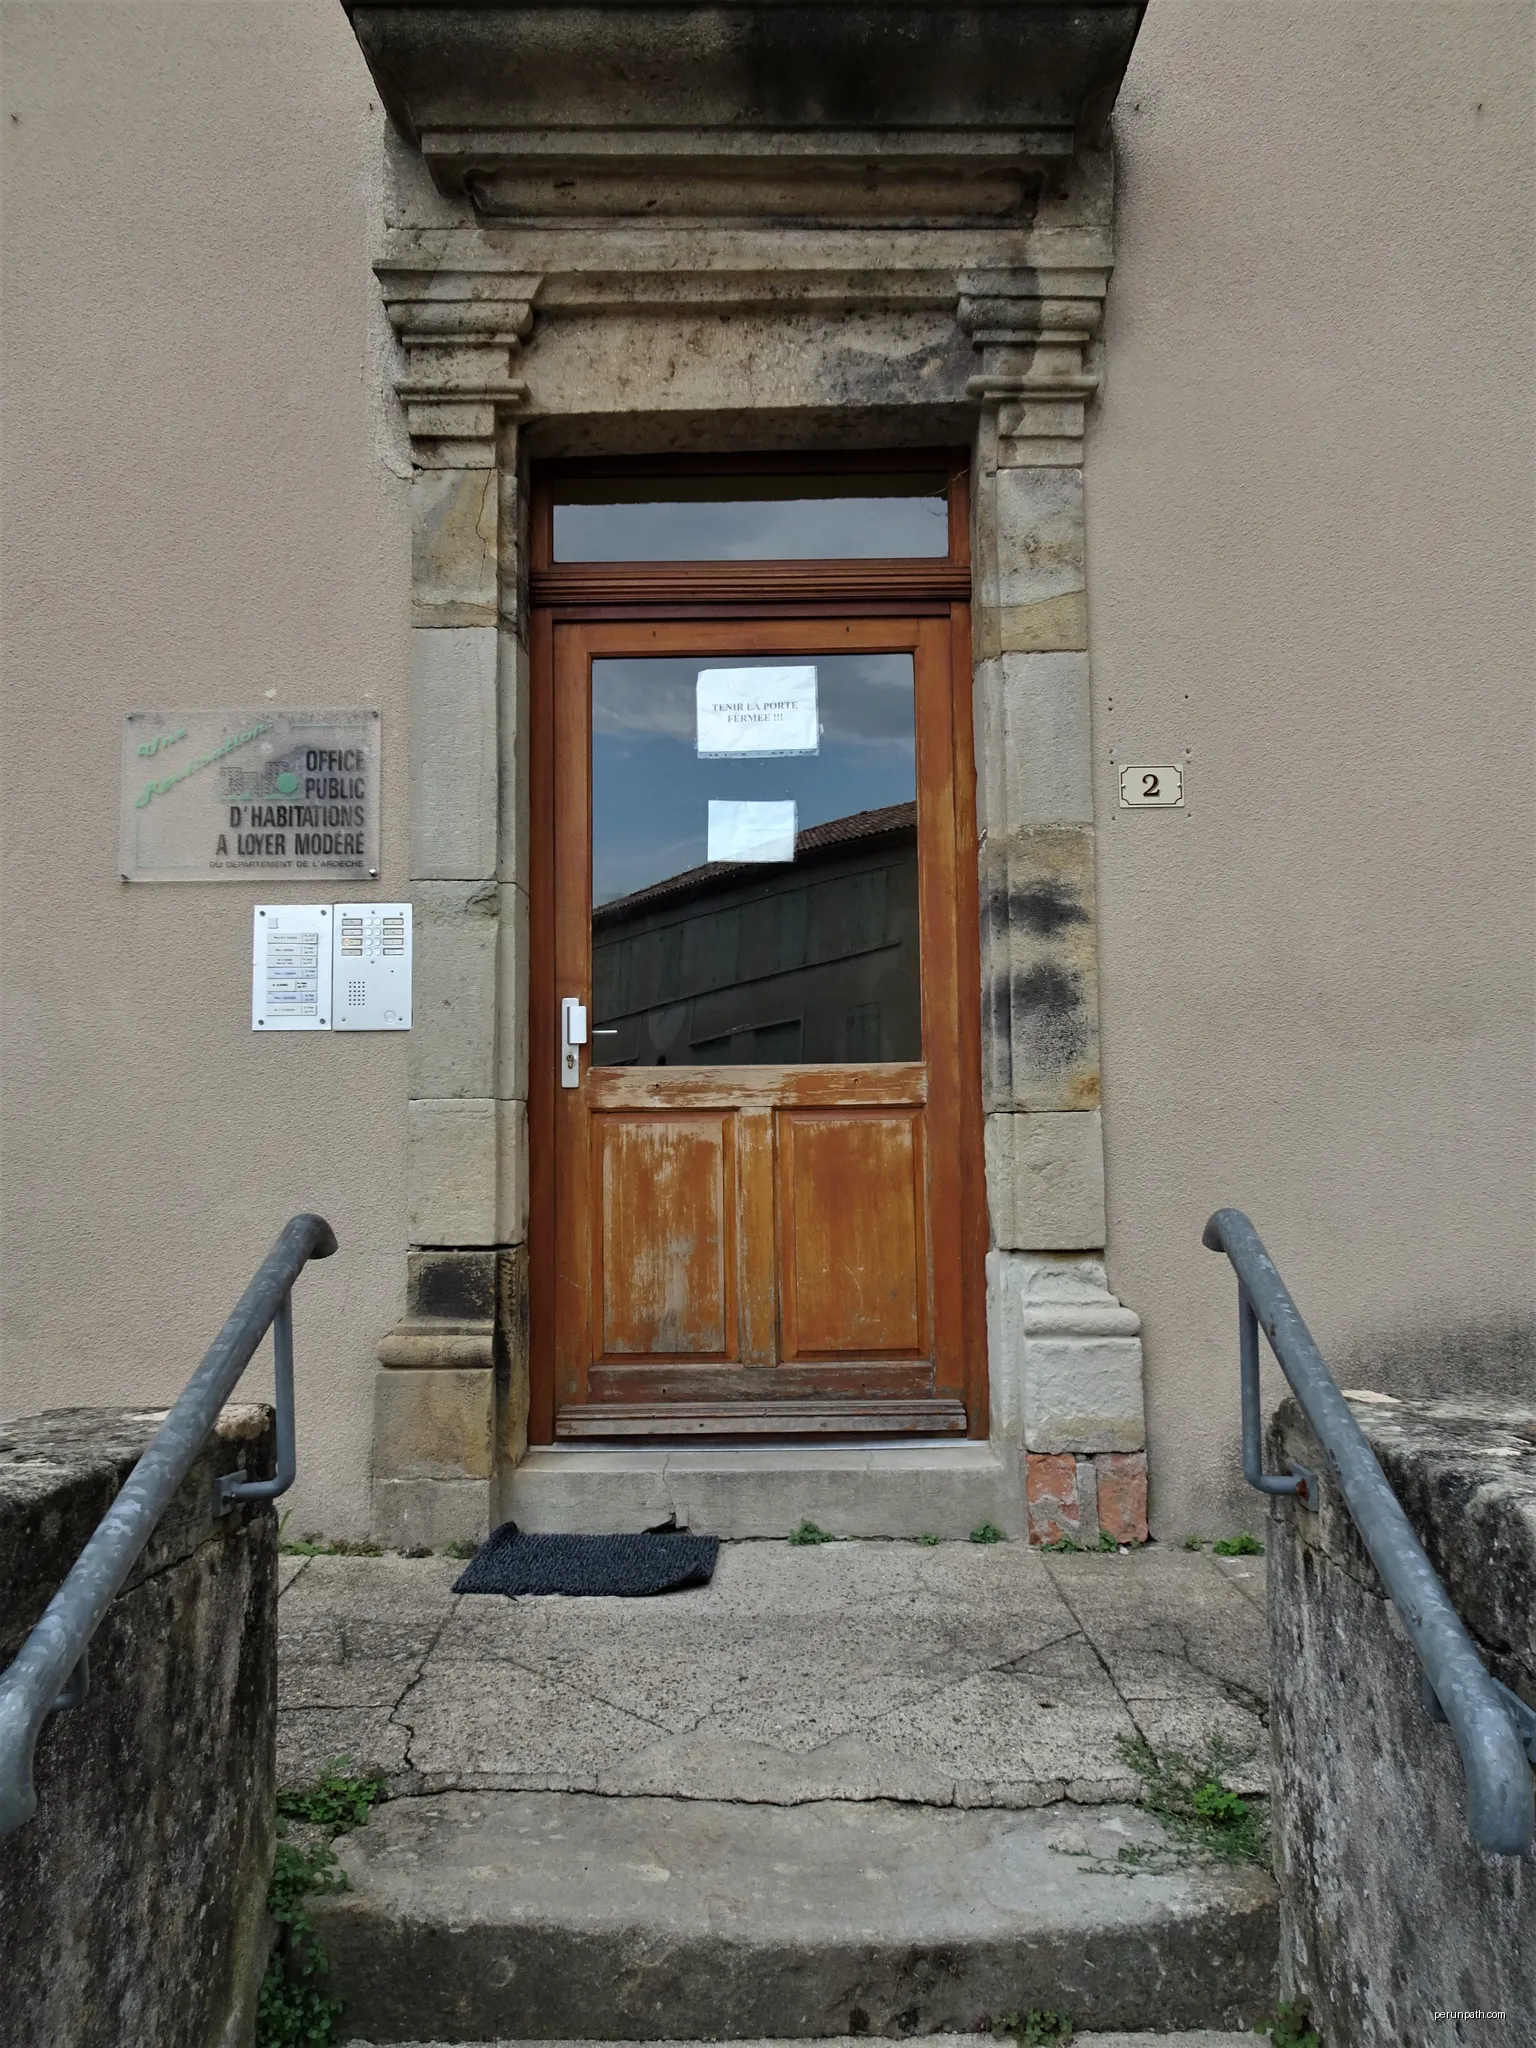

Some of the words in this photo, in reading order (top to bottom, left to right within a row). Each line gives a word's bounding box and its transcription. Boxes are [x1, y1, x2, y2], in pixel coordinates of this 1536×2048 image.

[712, 703, 744, 712] TENIR
[747, 702, 760, 711] LA
[763, 701, 798, 711] PORTE
[773, 713, 783, 722] !!!
[306, 749, 364, 771] OFFICE
[305, 777, 364, 799] PUBLIC
[1142, 774, 1160, 797] 2
[229, 805, 364, 828] D'HABITATIONS
[215, 833, 228, 855] A
[237, 832, 286, 855] LOYER
[295, 830, 364, 855] MODÉRÉ
[296, 860, 309, 868] DE
